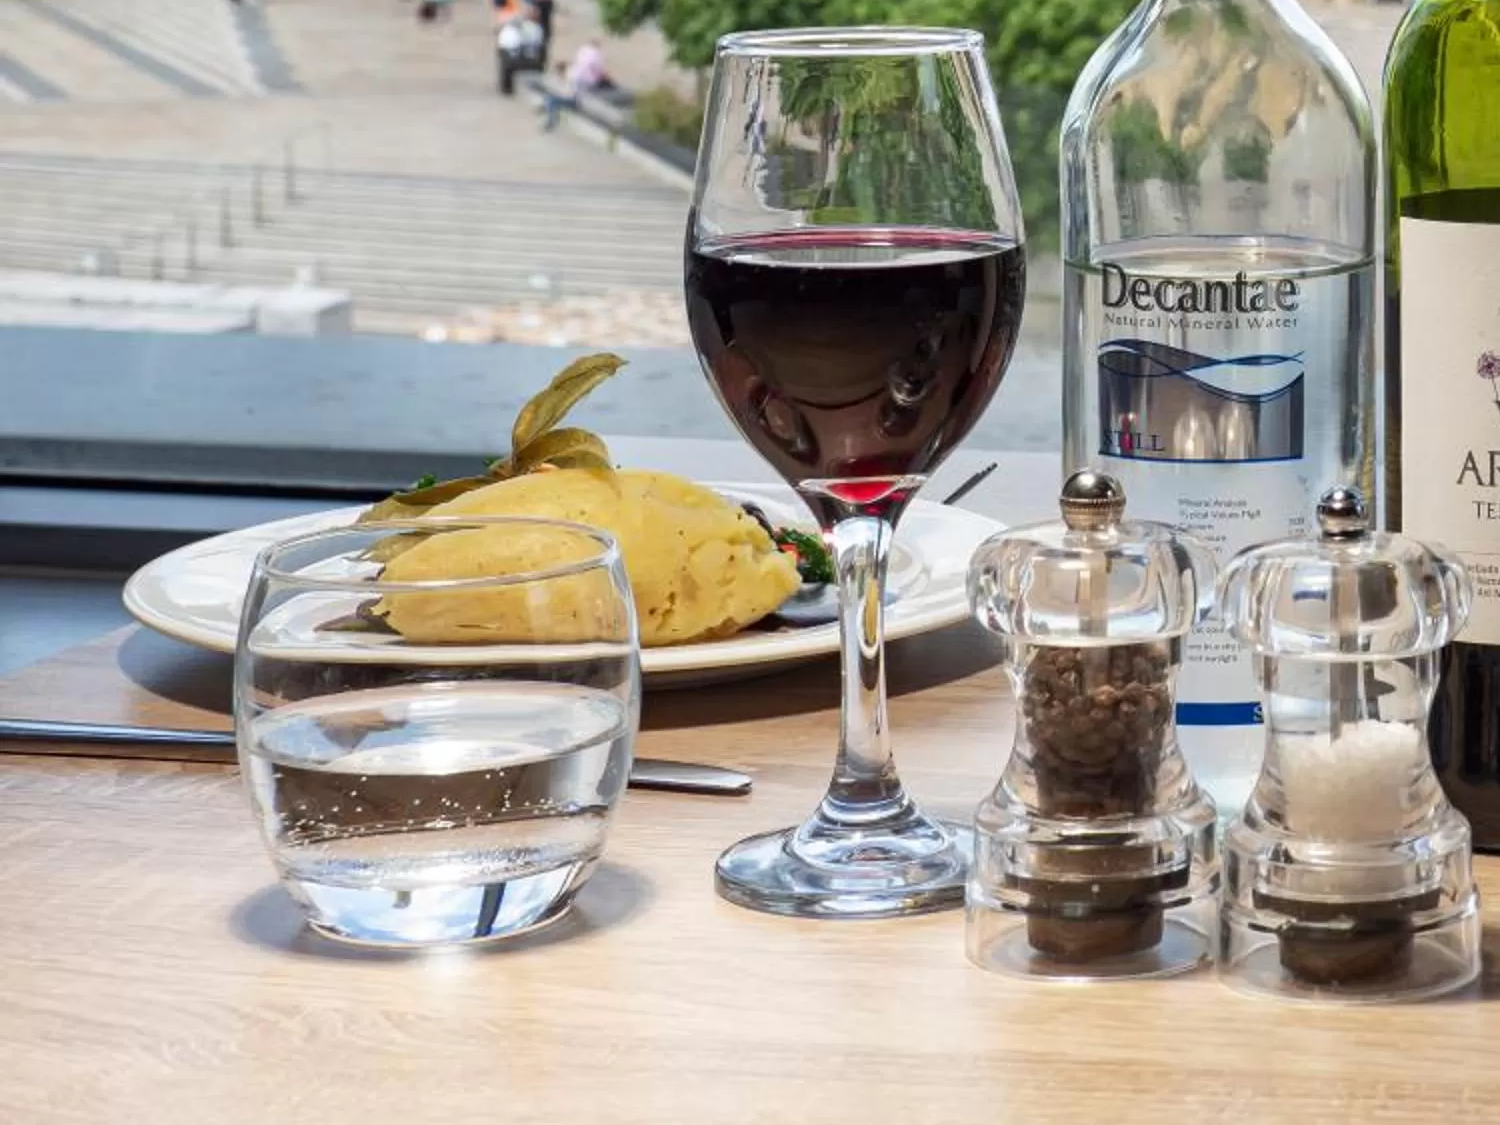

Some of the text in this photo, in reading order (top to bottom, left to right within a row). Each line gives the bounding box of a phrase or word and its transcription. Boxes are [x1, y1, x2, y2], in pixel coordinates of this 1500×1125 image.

[1101, 262, 1299, 313] Decantae
[1104, 312, 1298, 331] Natural Mineral Water
